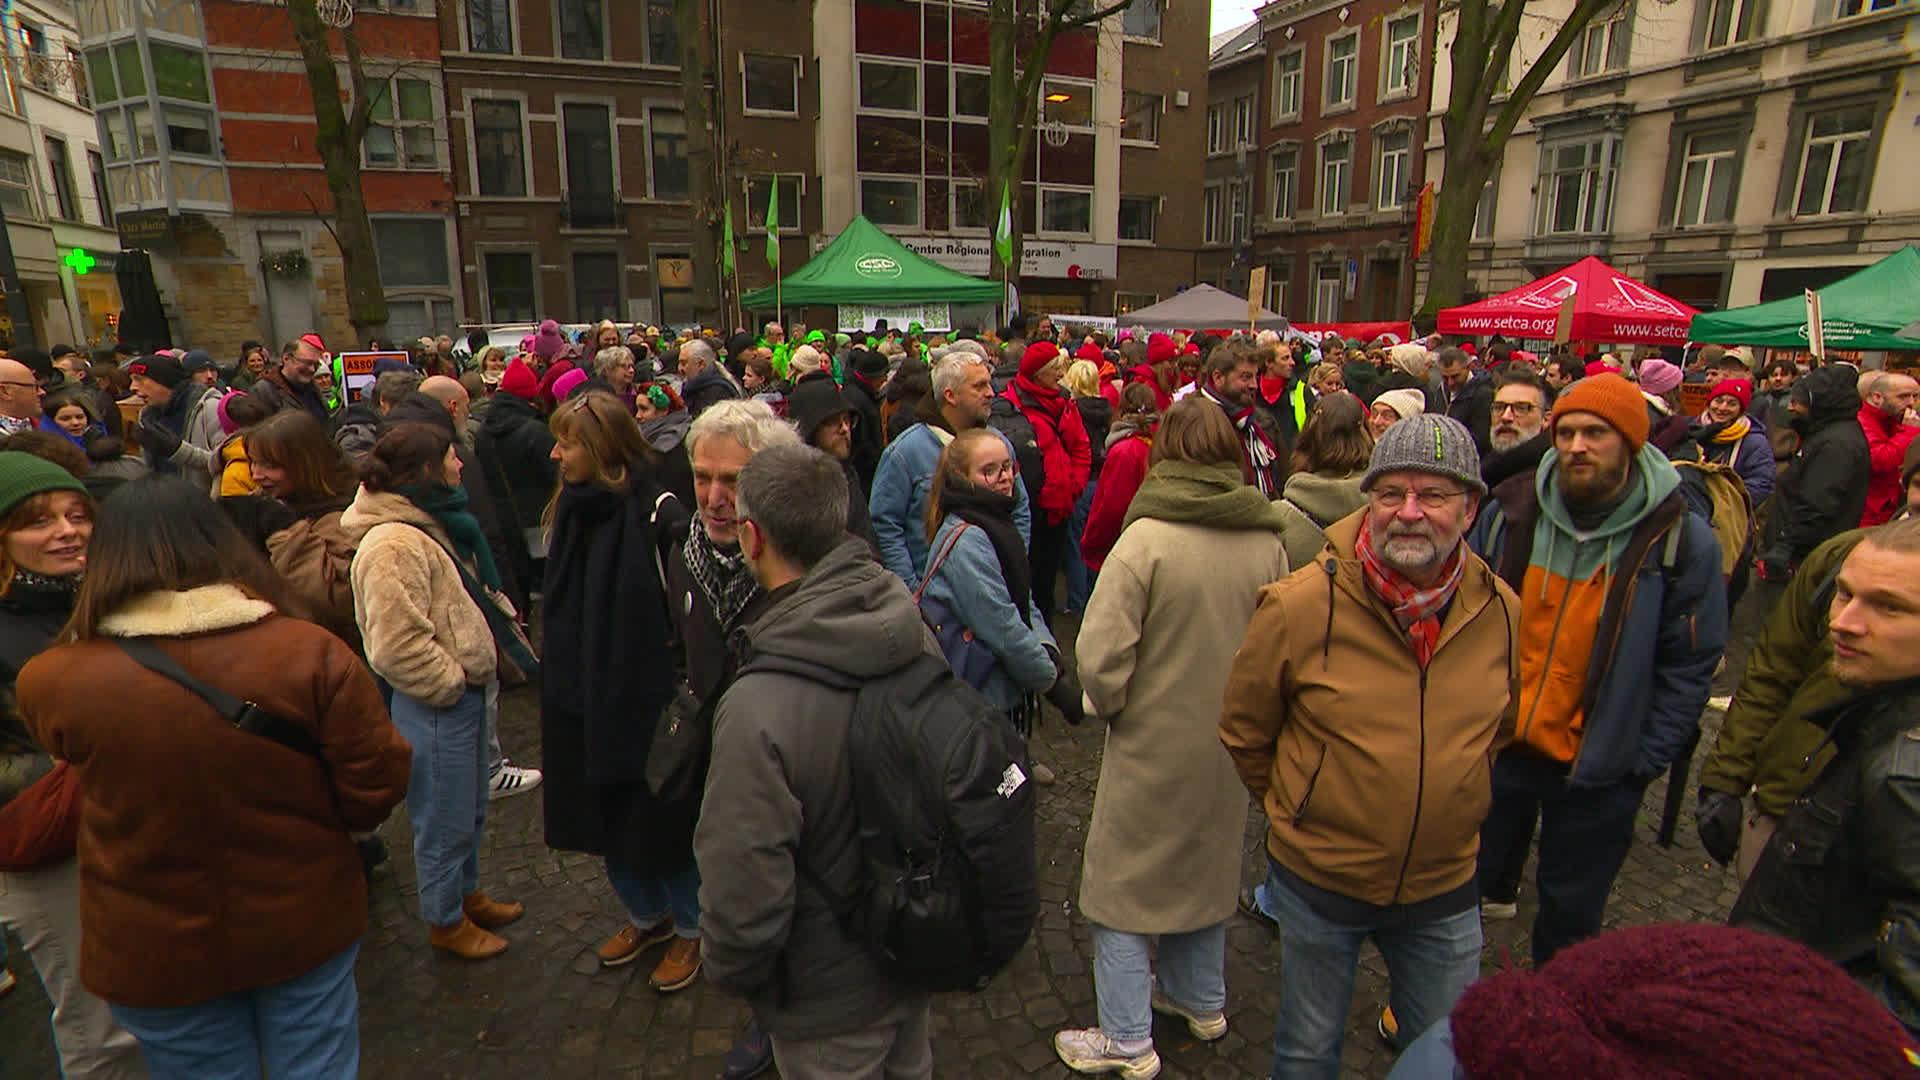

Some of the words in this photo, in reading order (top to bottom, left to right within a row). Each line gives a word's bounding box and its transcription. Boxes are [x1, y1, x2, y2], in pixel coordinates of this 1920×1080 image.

[946, 245, 989, 256] Régiona
[1024, 247, 1061, 258] gration
[1459, 317, 1556, 334] www.setca.org
[1613, 323, 1689, 338] www.setca
[346, 359, 374, 370] ASSO
